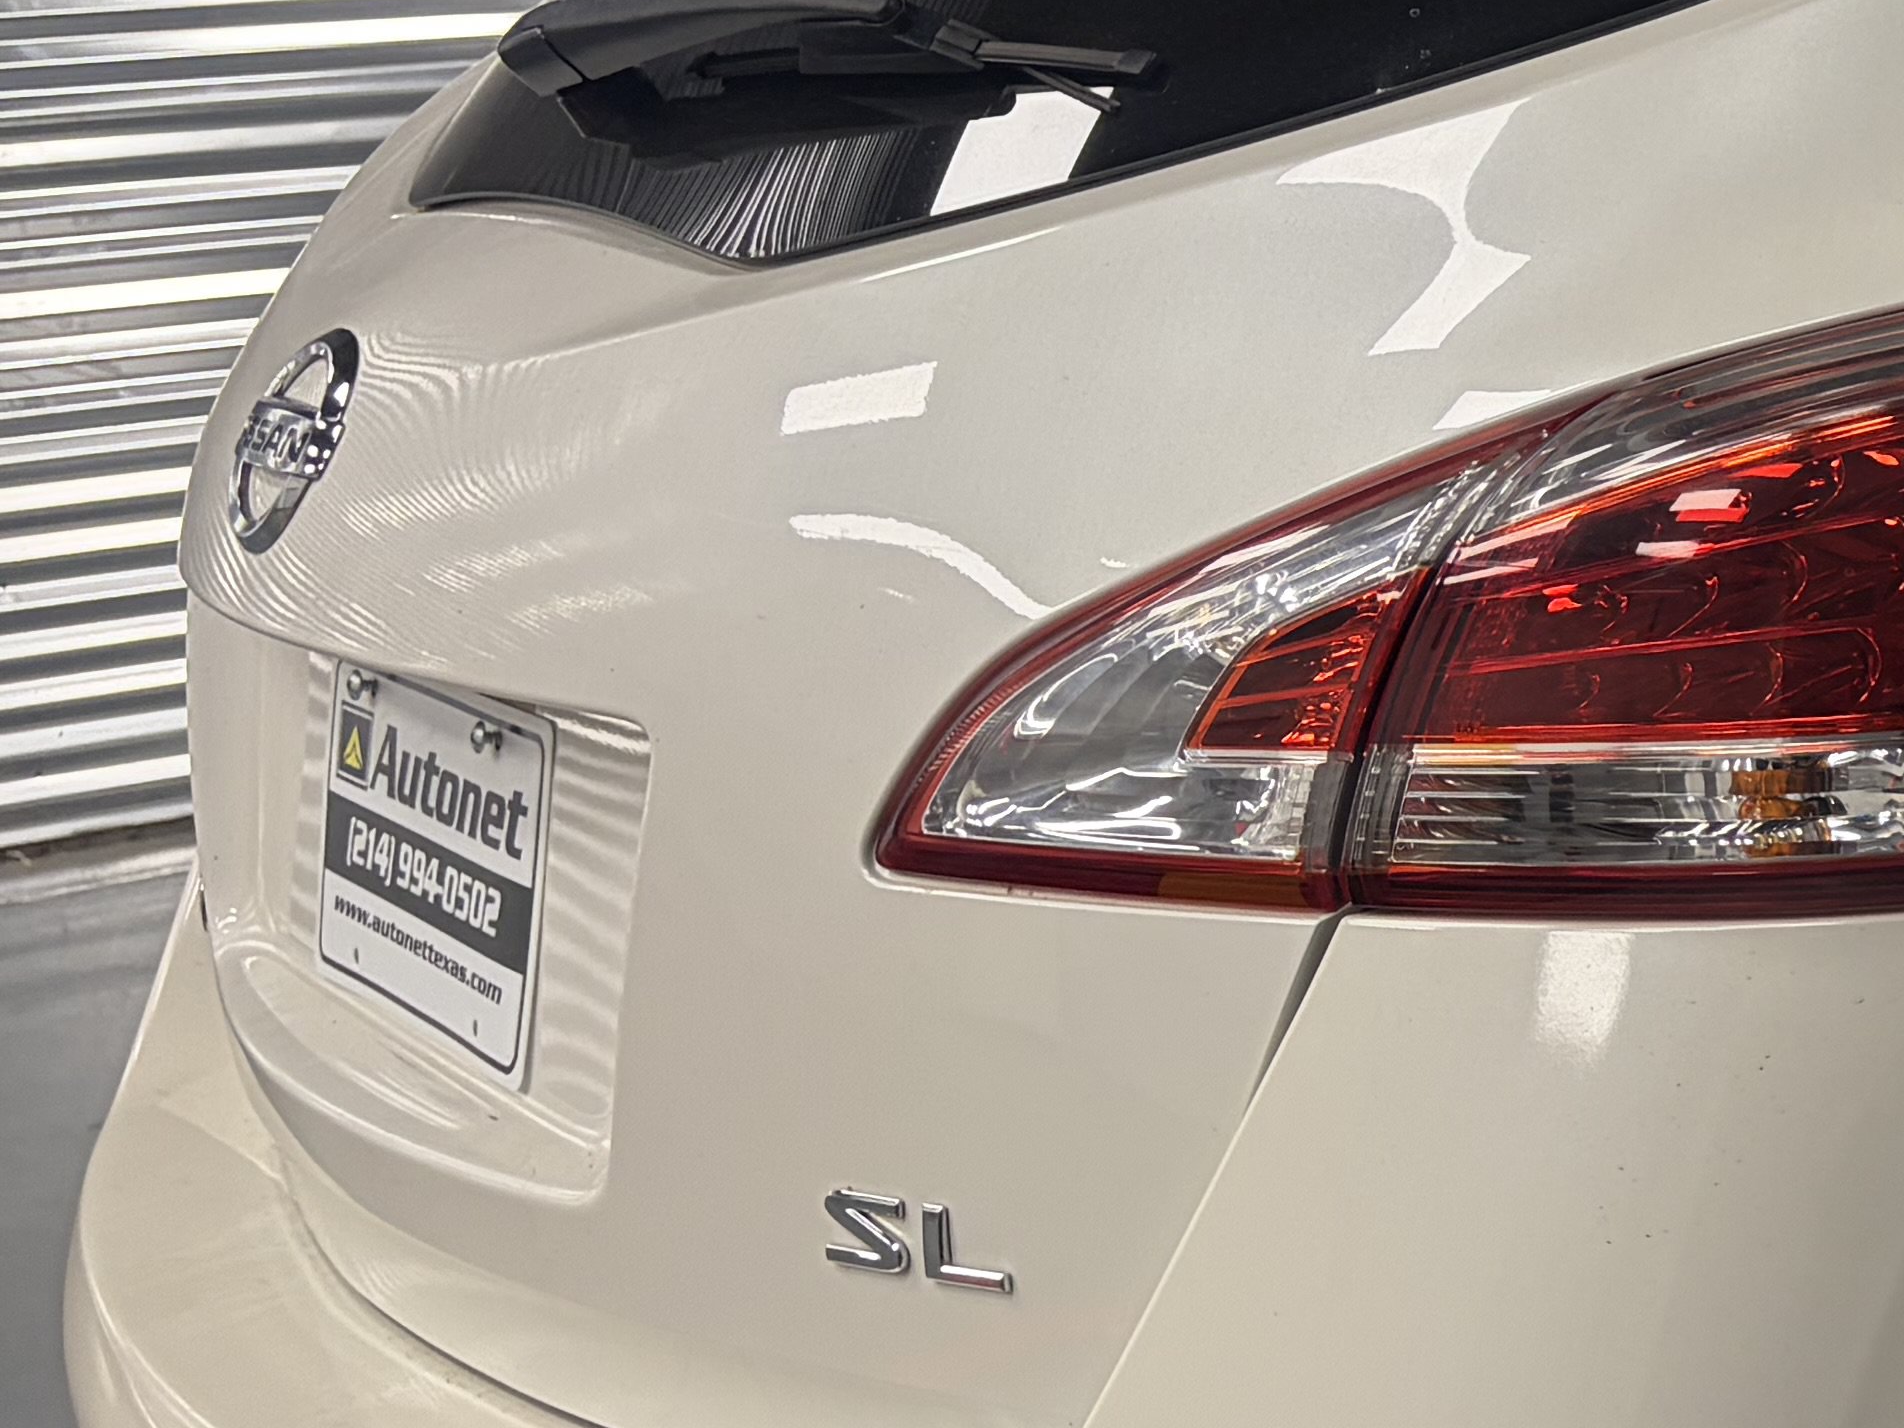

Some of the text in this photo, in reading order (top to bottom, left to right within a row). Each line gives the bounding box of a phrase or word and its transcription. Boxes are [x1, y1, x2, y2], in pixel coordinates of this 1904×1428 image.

[369, 723, 529, 861] Autonet
[346, 815, 502, 939] (214) 994-0502
[334, 894, 503, 1006] www.autonettexas.com
[824, 1186, 1014, 1295] SL
